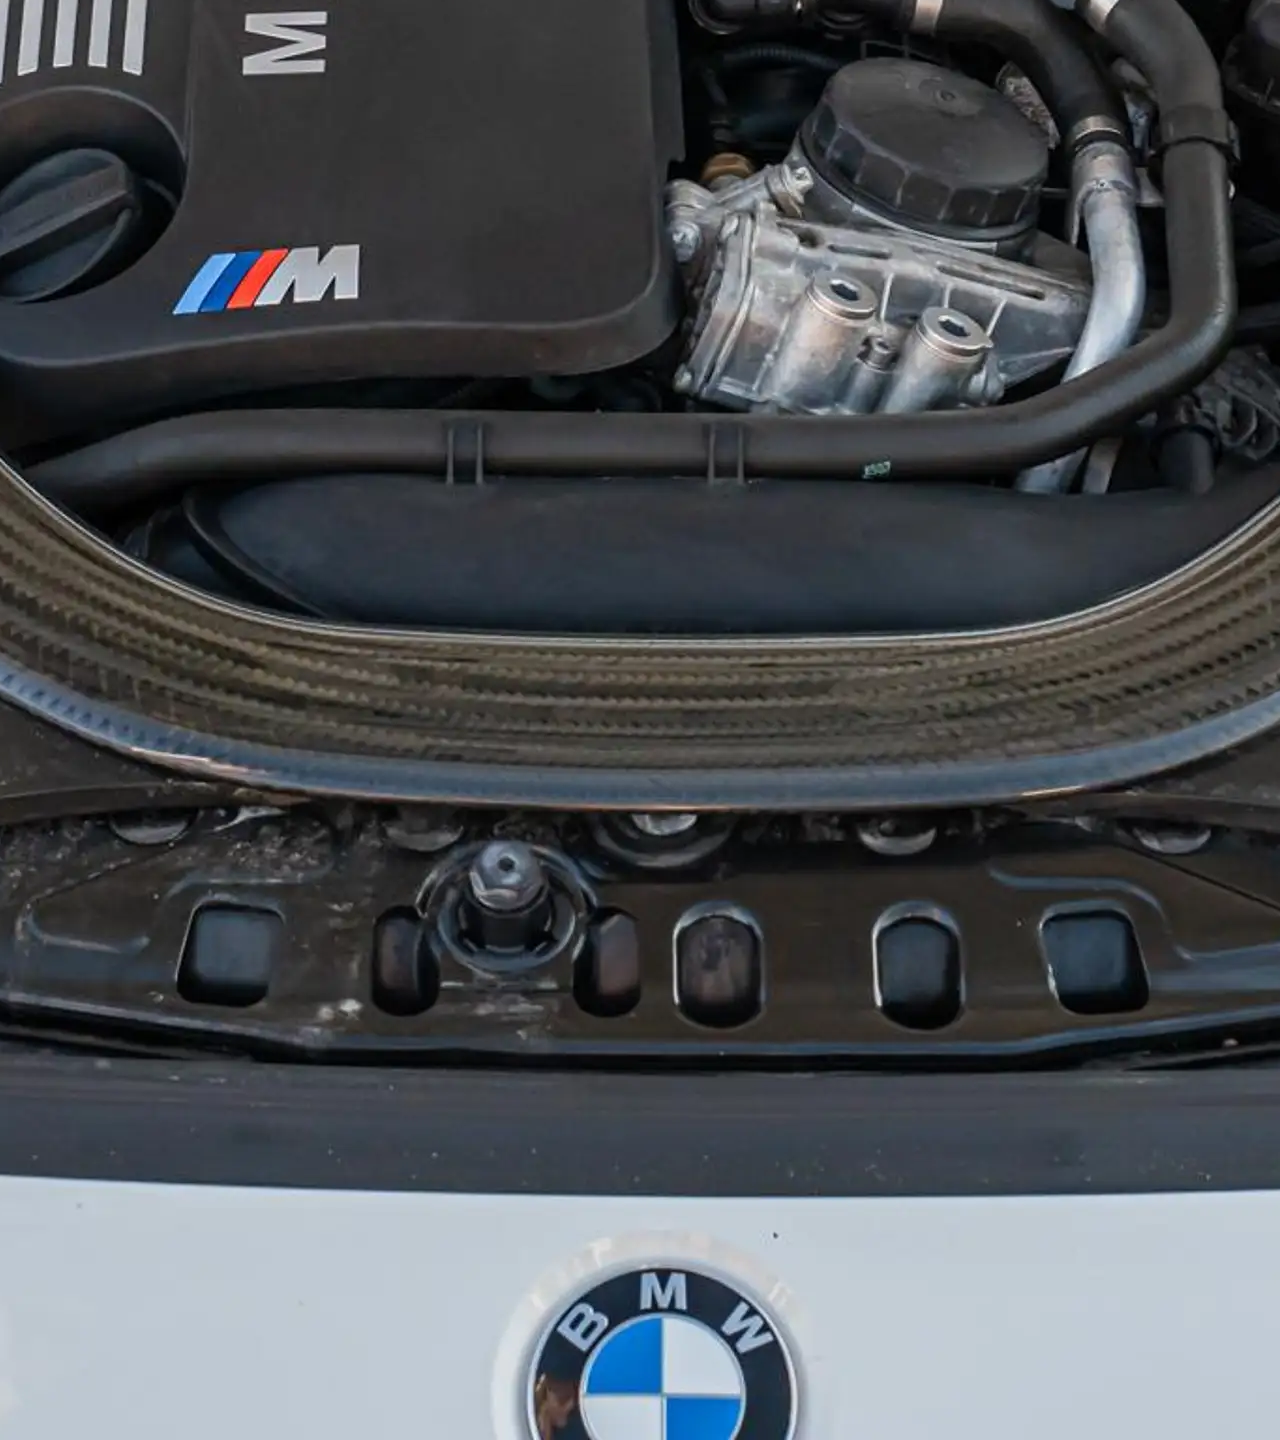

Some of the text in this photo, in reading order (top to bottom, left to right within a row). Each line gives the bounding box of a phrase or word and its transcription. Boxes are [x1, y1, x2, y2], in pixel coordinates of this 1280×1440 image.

[242, 11, 328, 76] M
[254, 244, 360, 307] M
[556, 1271, 774, 1354] BMW
